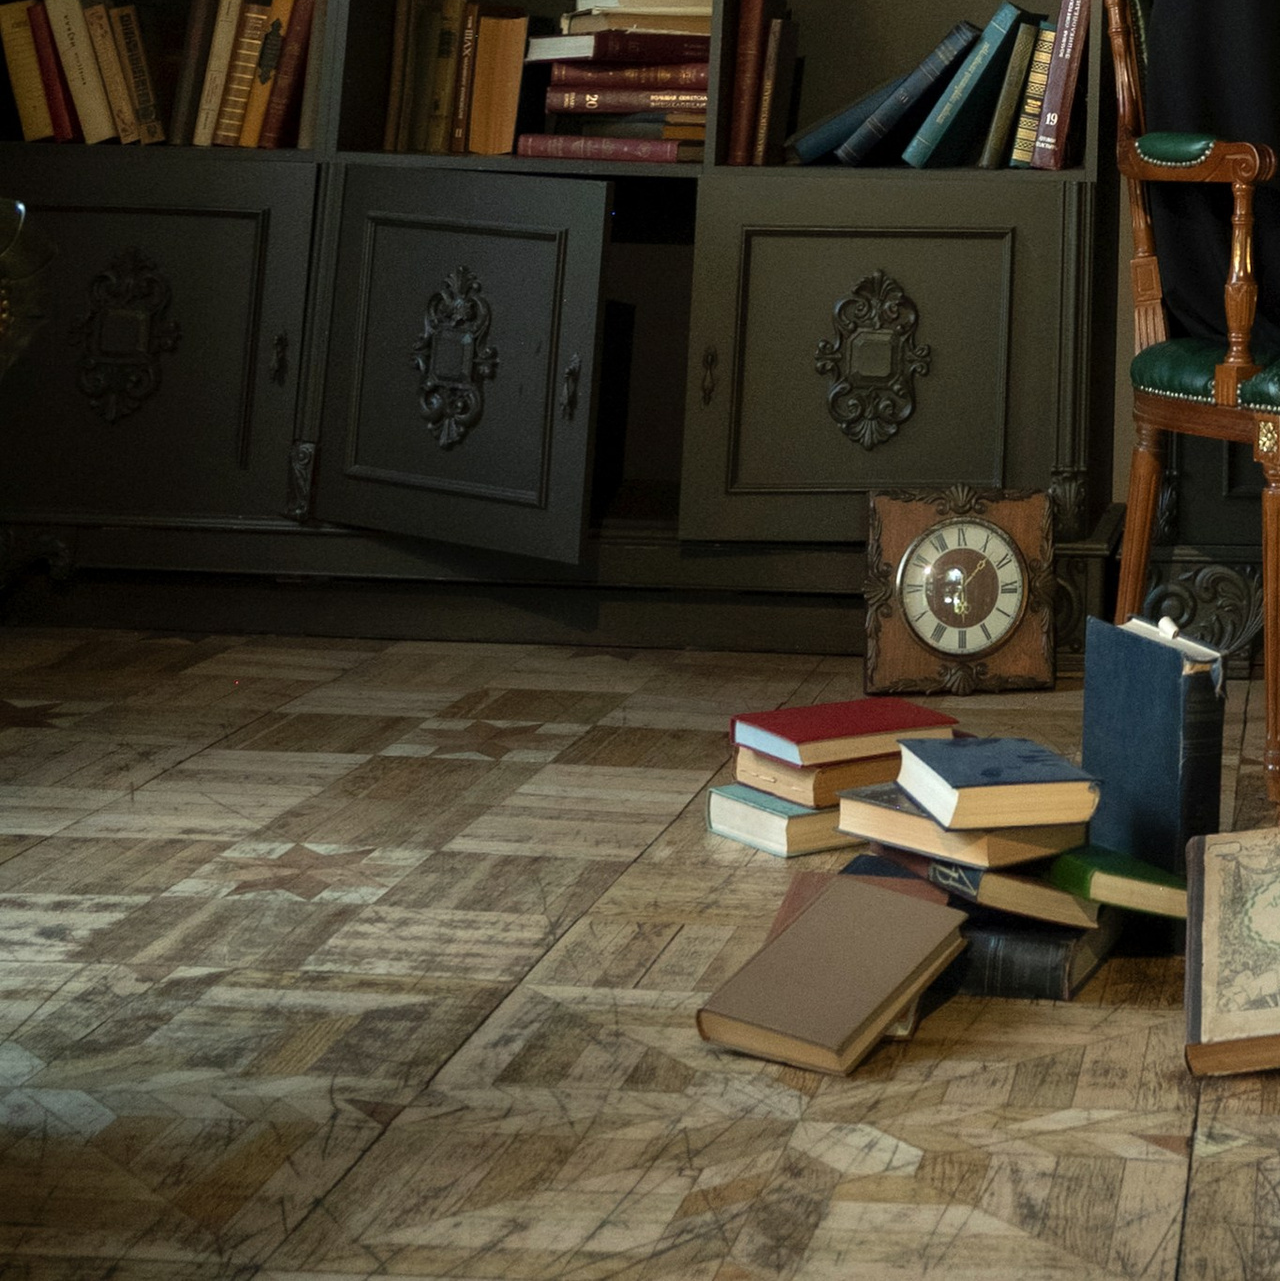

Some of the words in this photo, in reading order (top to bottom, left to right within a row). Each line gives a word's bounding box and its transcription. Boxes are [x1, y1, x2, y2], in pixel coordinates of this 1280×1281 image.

[461, 29, 473, 57] XVIII
[1057, 29, 1069, 58] БОЛЬШАЯ
[585, 93, 598, 108] 20
[1045, 112, 1058, 126] 19
